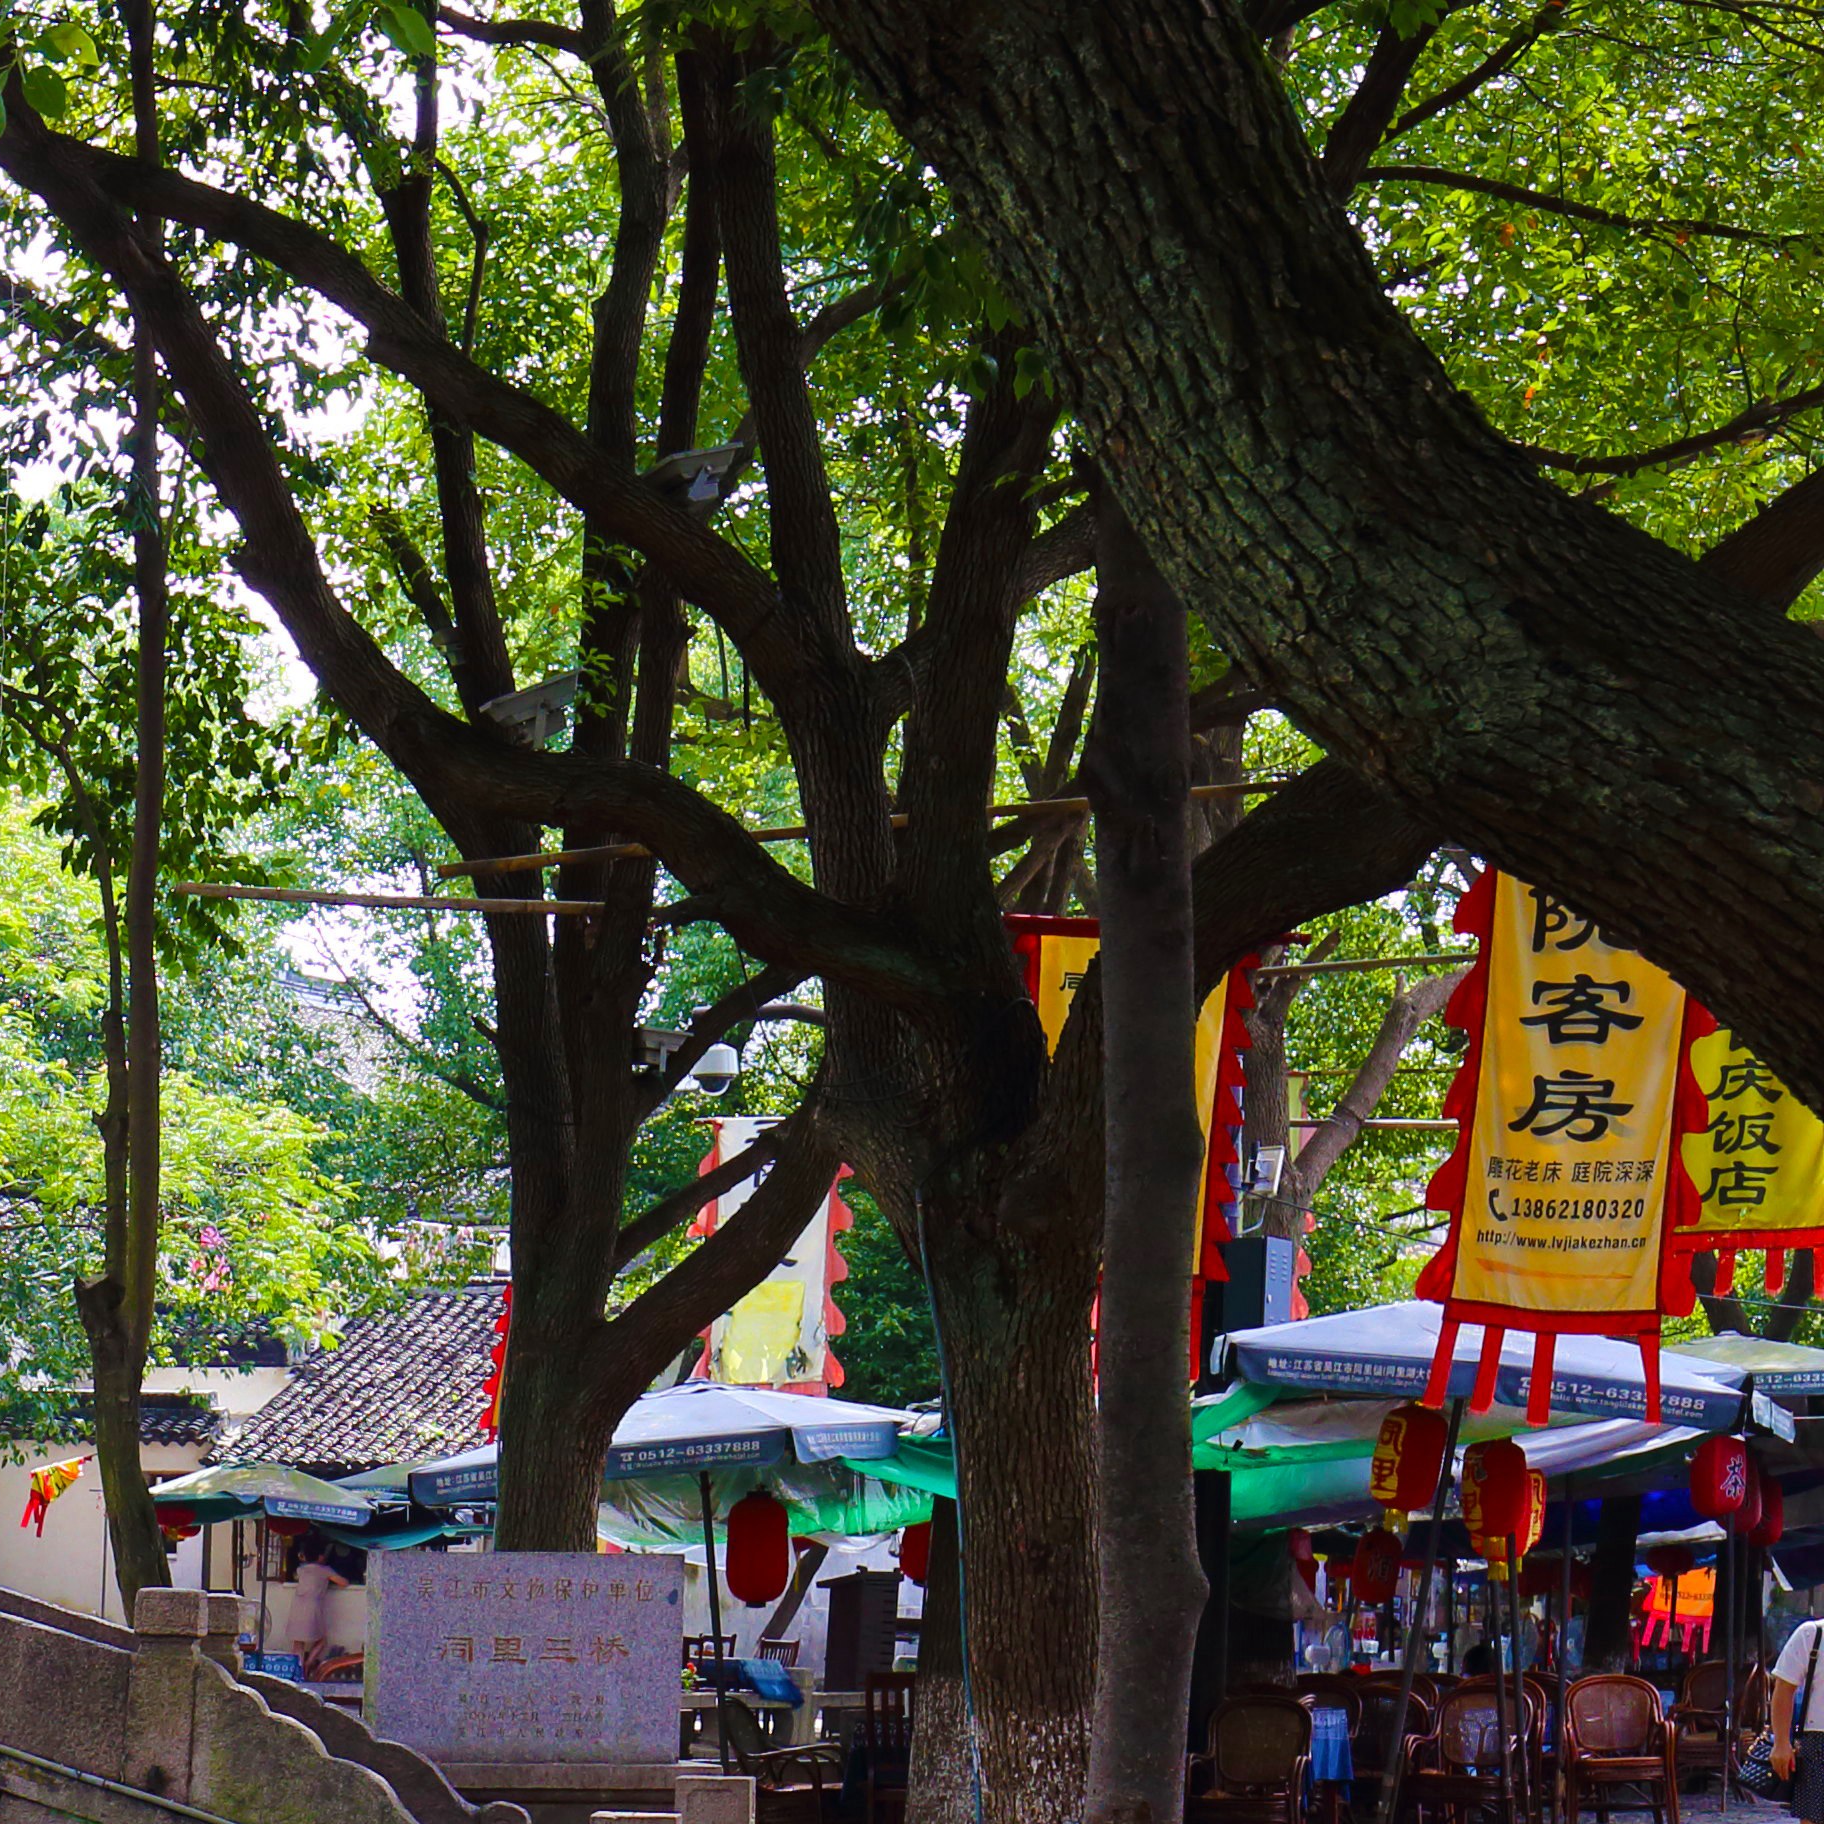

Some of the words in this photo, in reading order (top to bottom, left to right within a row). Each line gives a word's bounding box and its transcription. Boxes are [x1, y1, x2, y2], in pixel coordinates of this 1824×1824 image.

[1702, 1042, 1784, 1206] 庆饭店
[1487, 1155, 1563, 1183] 雕花老床
[1570, 1159, 1656, 1184] 庭院深深
[1510, 1197, 1645, 1220] 13862180320
[1476, 1229, 1647, 1252] http://www.lvjiakezhan.cn
[1551, 1382, 1706, 1411] 512-6337888
[638, 1440, 760, 1461] 0512-63337888
[1720, 1454, 1746, 1500] 茶
[416, 1577, 655, 1603] 吴江市文物保护单位
